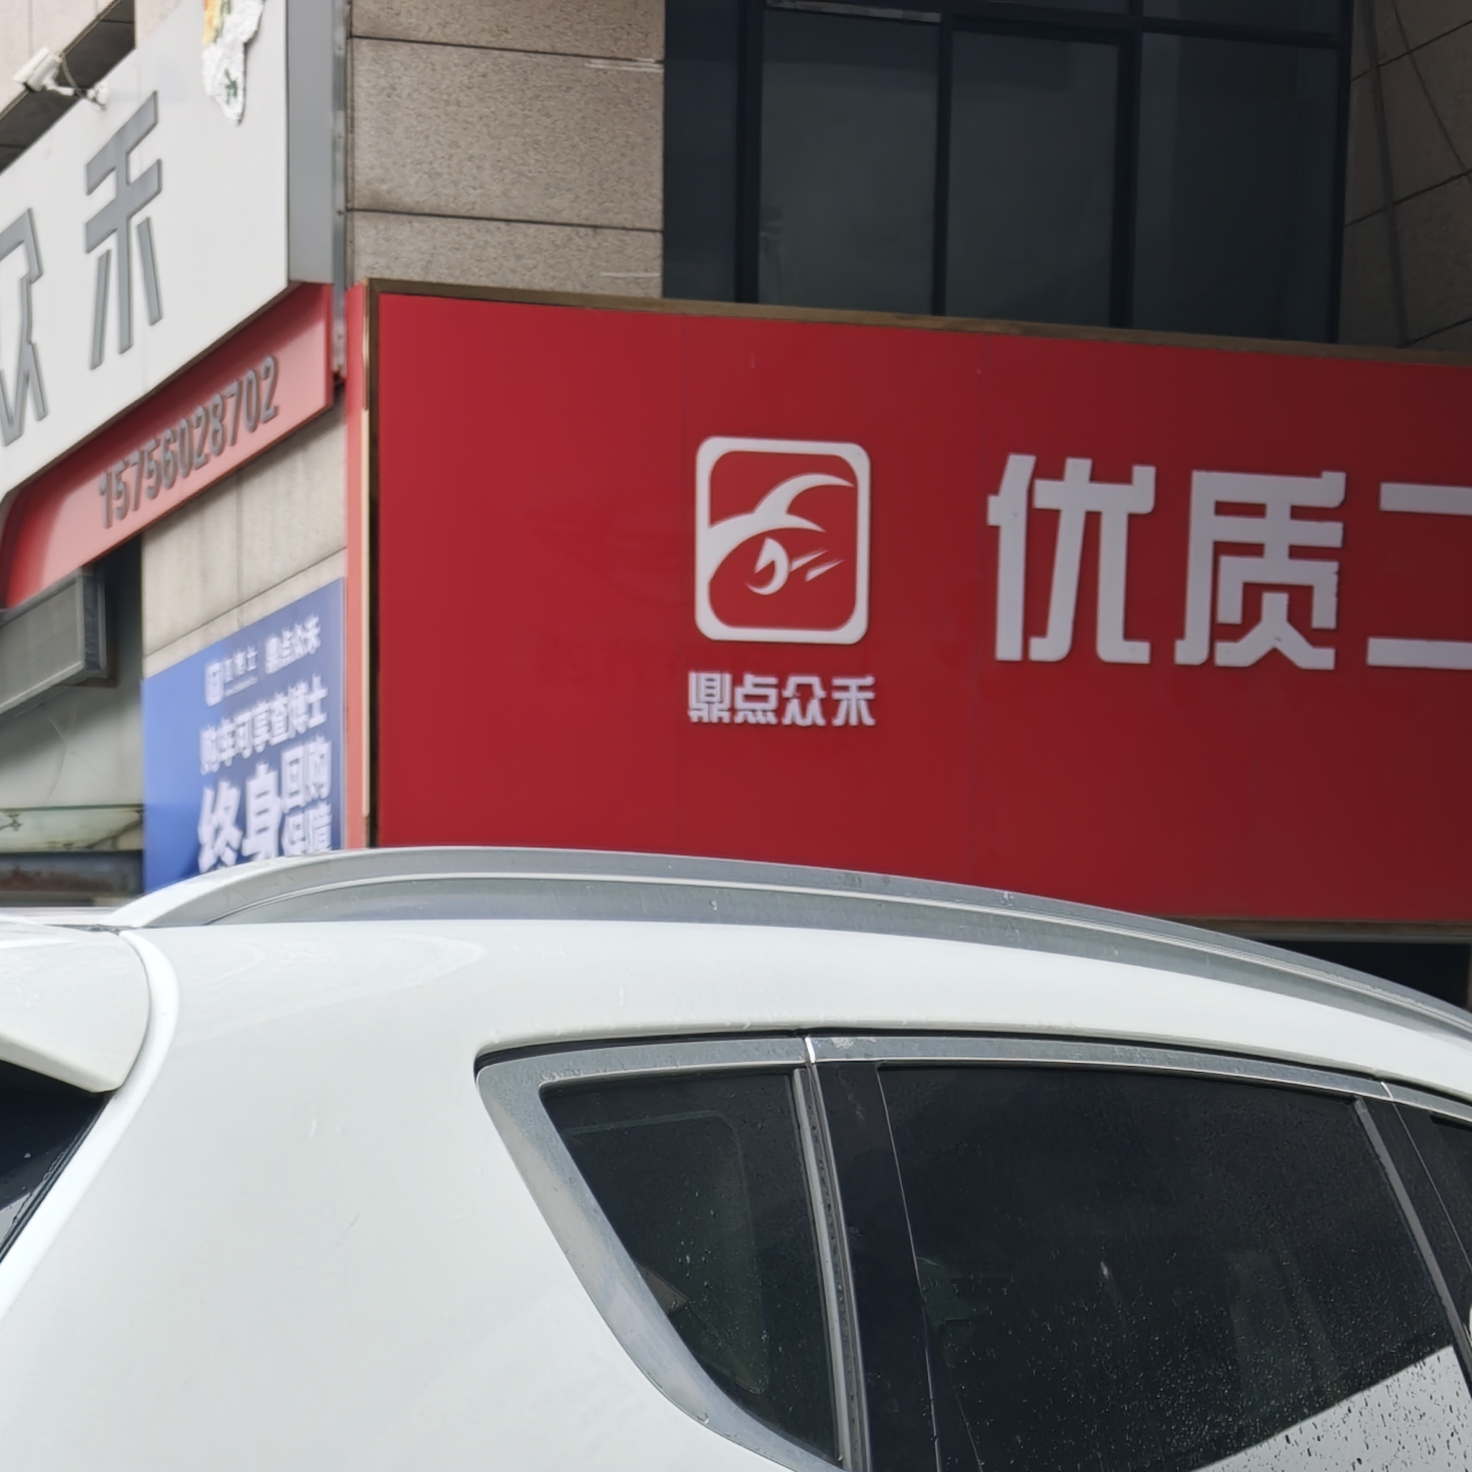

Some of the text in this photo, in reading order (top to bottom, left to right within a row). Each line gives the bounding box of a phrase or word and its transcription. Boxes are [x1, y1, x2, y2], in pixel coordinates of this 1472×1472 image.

[100, 355, 279, 530] 15756028702
[687, 671, 876, 728] 鼎点众禾
